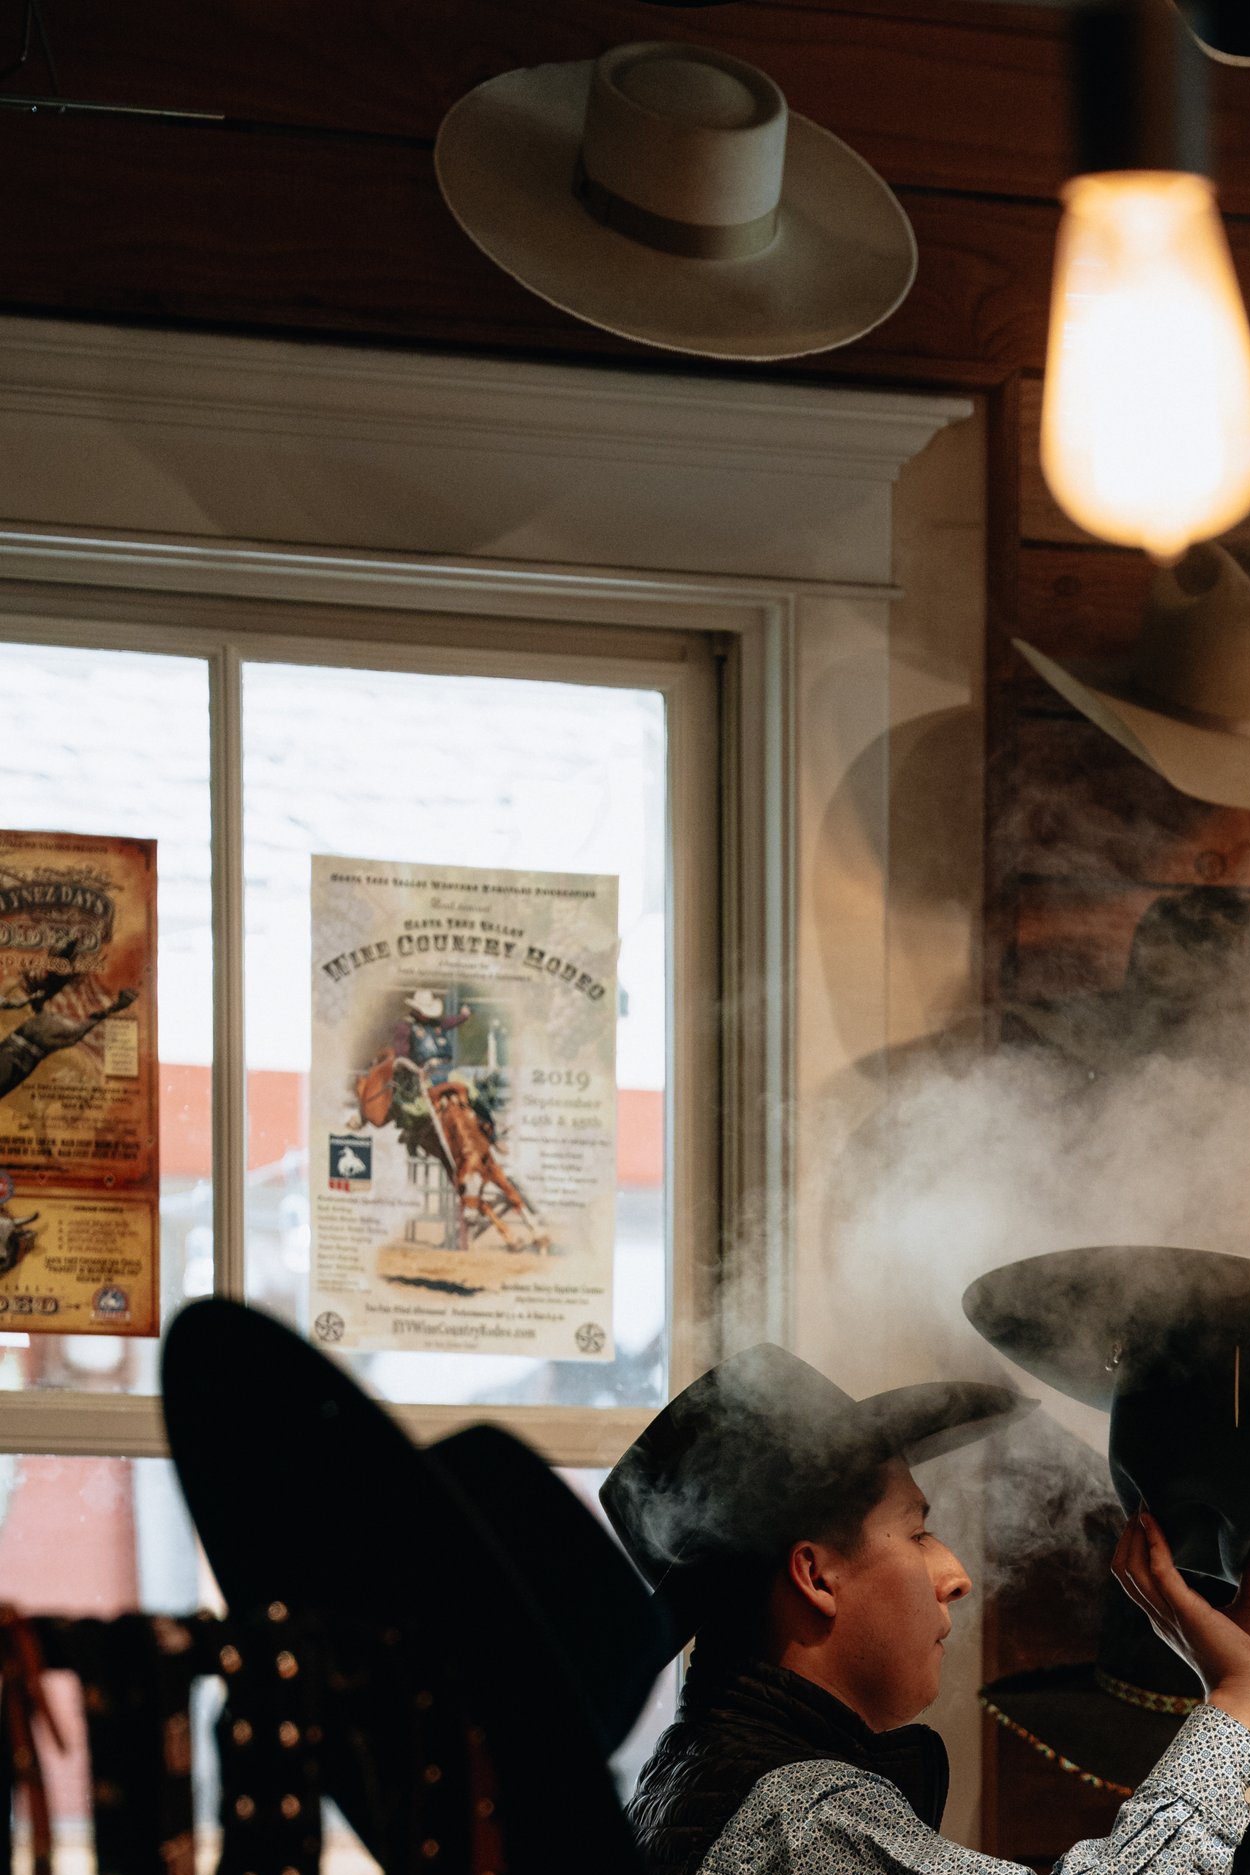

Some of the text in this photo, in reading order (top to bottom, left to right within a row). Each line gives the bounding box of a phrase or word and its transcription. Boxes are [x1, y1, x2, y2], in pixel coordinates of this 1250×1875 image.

[321, 940, 391, 982] WINE
[396, 934, 516, 959] COUNTRY
[524, 944, 606, 1003] RODEO
[531, 1069, 591, 1092] 2019
